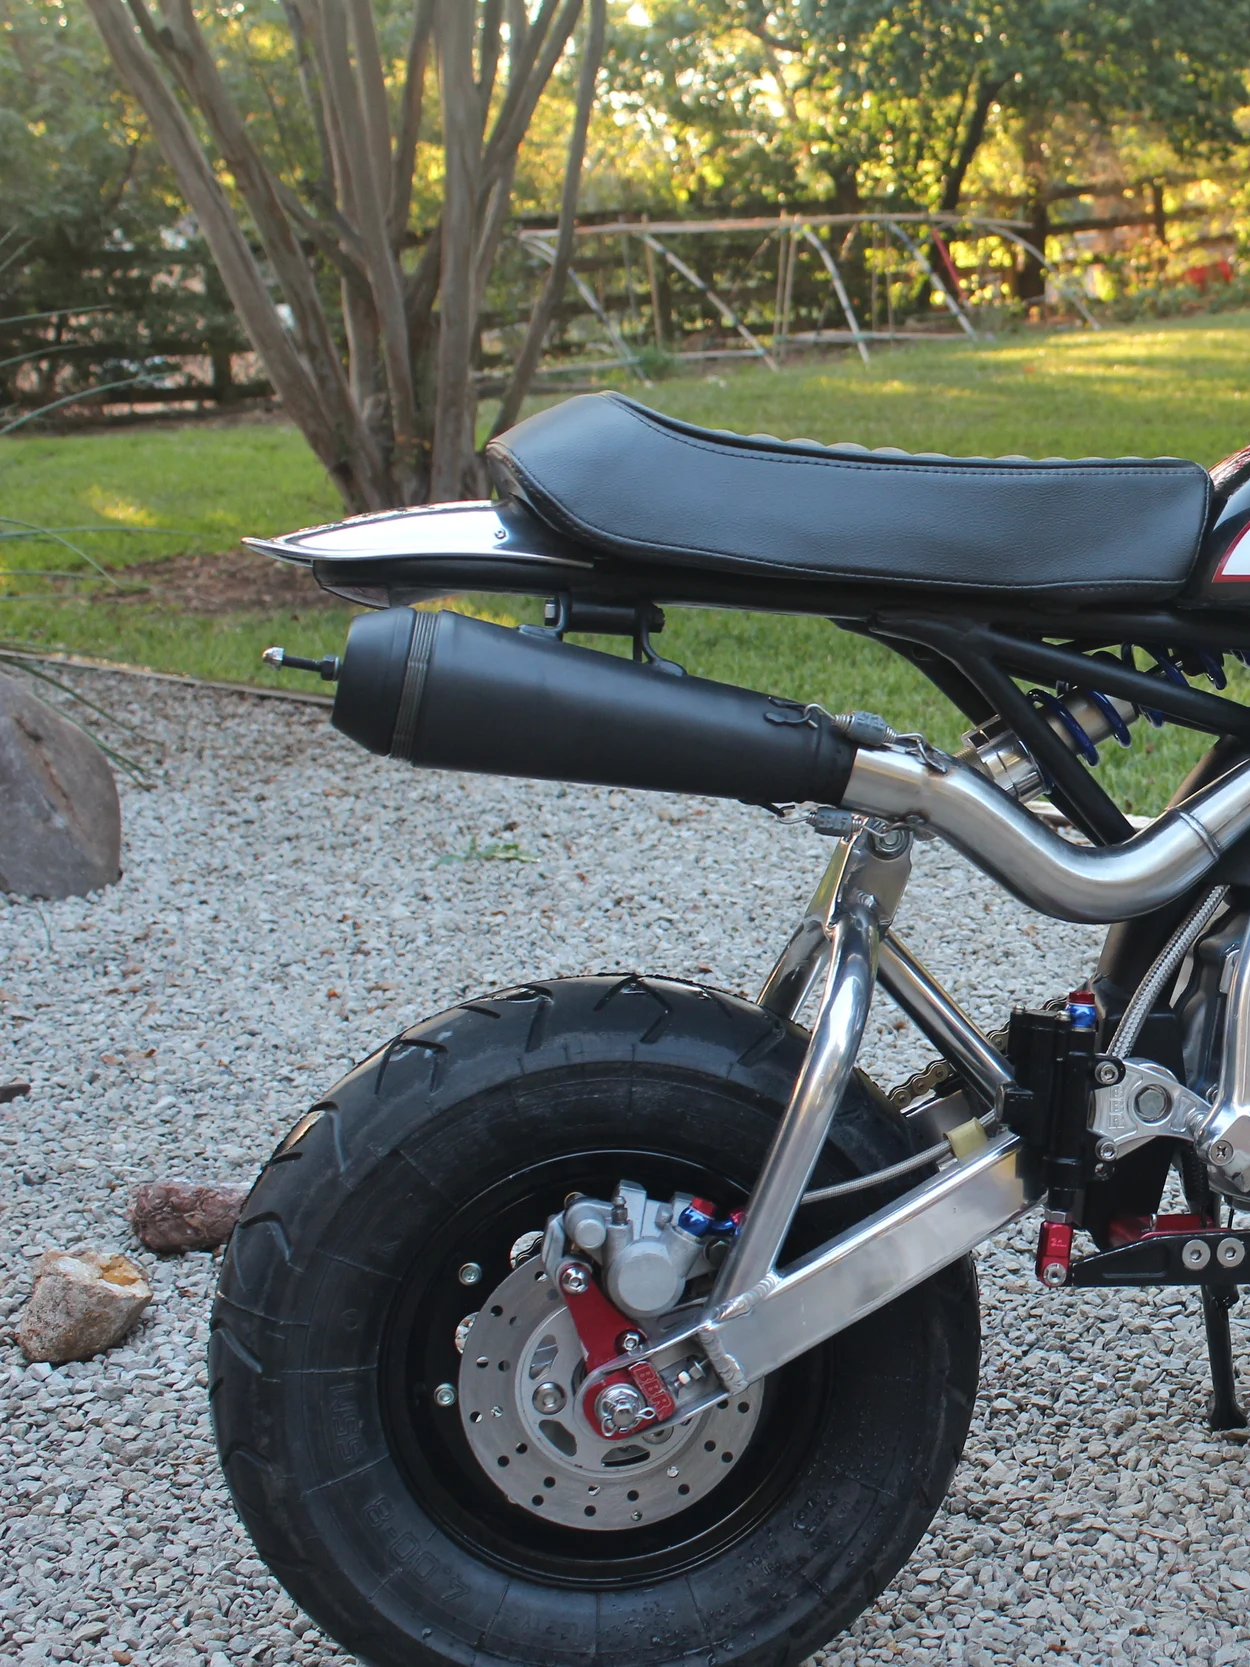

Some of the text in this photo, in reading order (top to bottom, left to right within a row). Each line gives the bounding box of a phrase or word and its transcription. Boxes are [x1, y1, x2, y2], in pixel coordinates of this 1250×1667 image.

[632, 1364, 673, 1414] BBR
[329, 1382, 471, 1603] 4.00-8 55M
